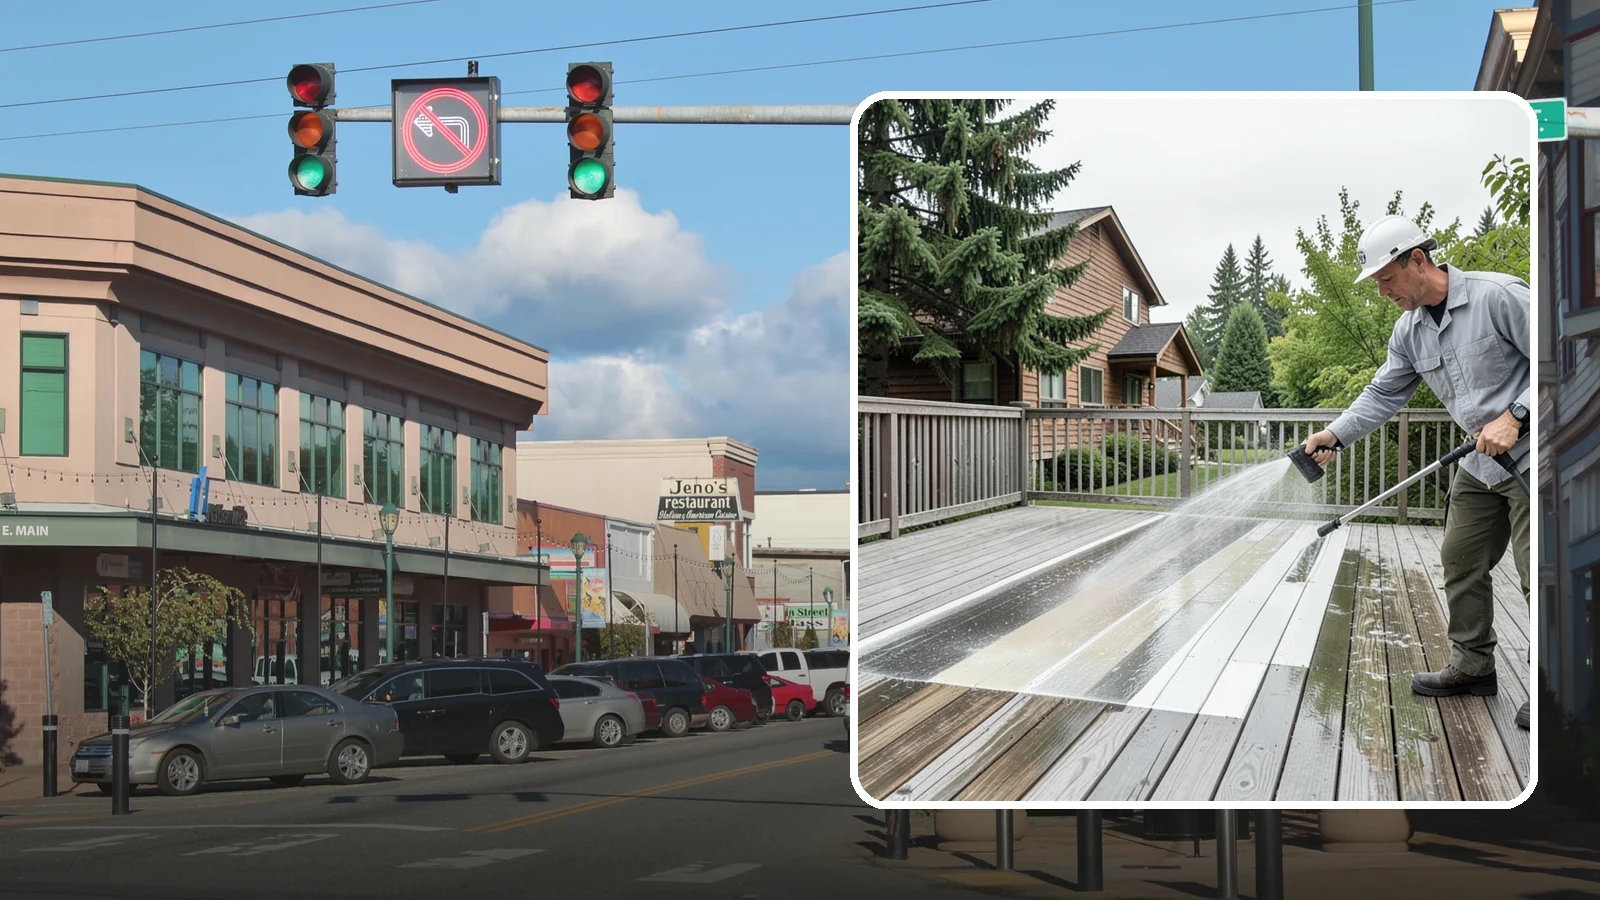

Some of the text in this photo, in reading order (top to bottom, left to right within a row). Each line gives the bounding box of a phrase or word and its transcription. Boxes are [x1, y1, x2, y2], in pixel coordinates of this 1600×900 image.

[670, 480, 727, 494] Jeno's
[665, 496, 731, 509] restaurant
[686, 509, 714, 519] American
[714, 509, 738, 519] Cuisine
[2, 525, 49, 536] E. MAIN
[797, 607, 828, 617] Street
